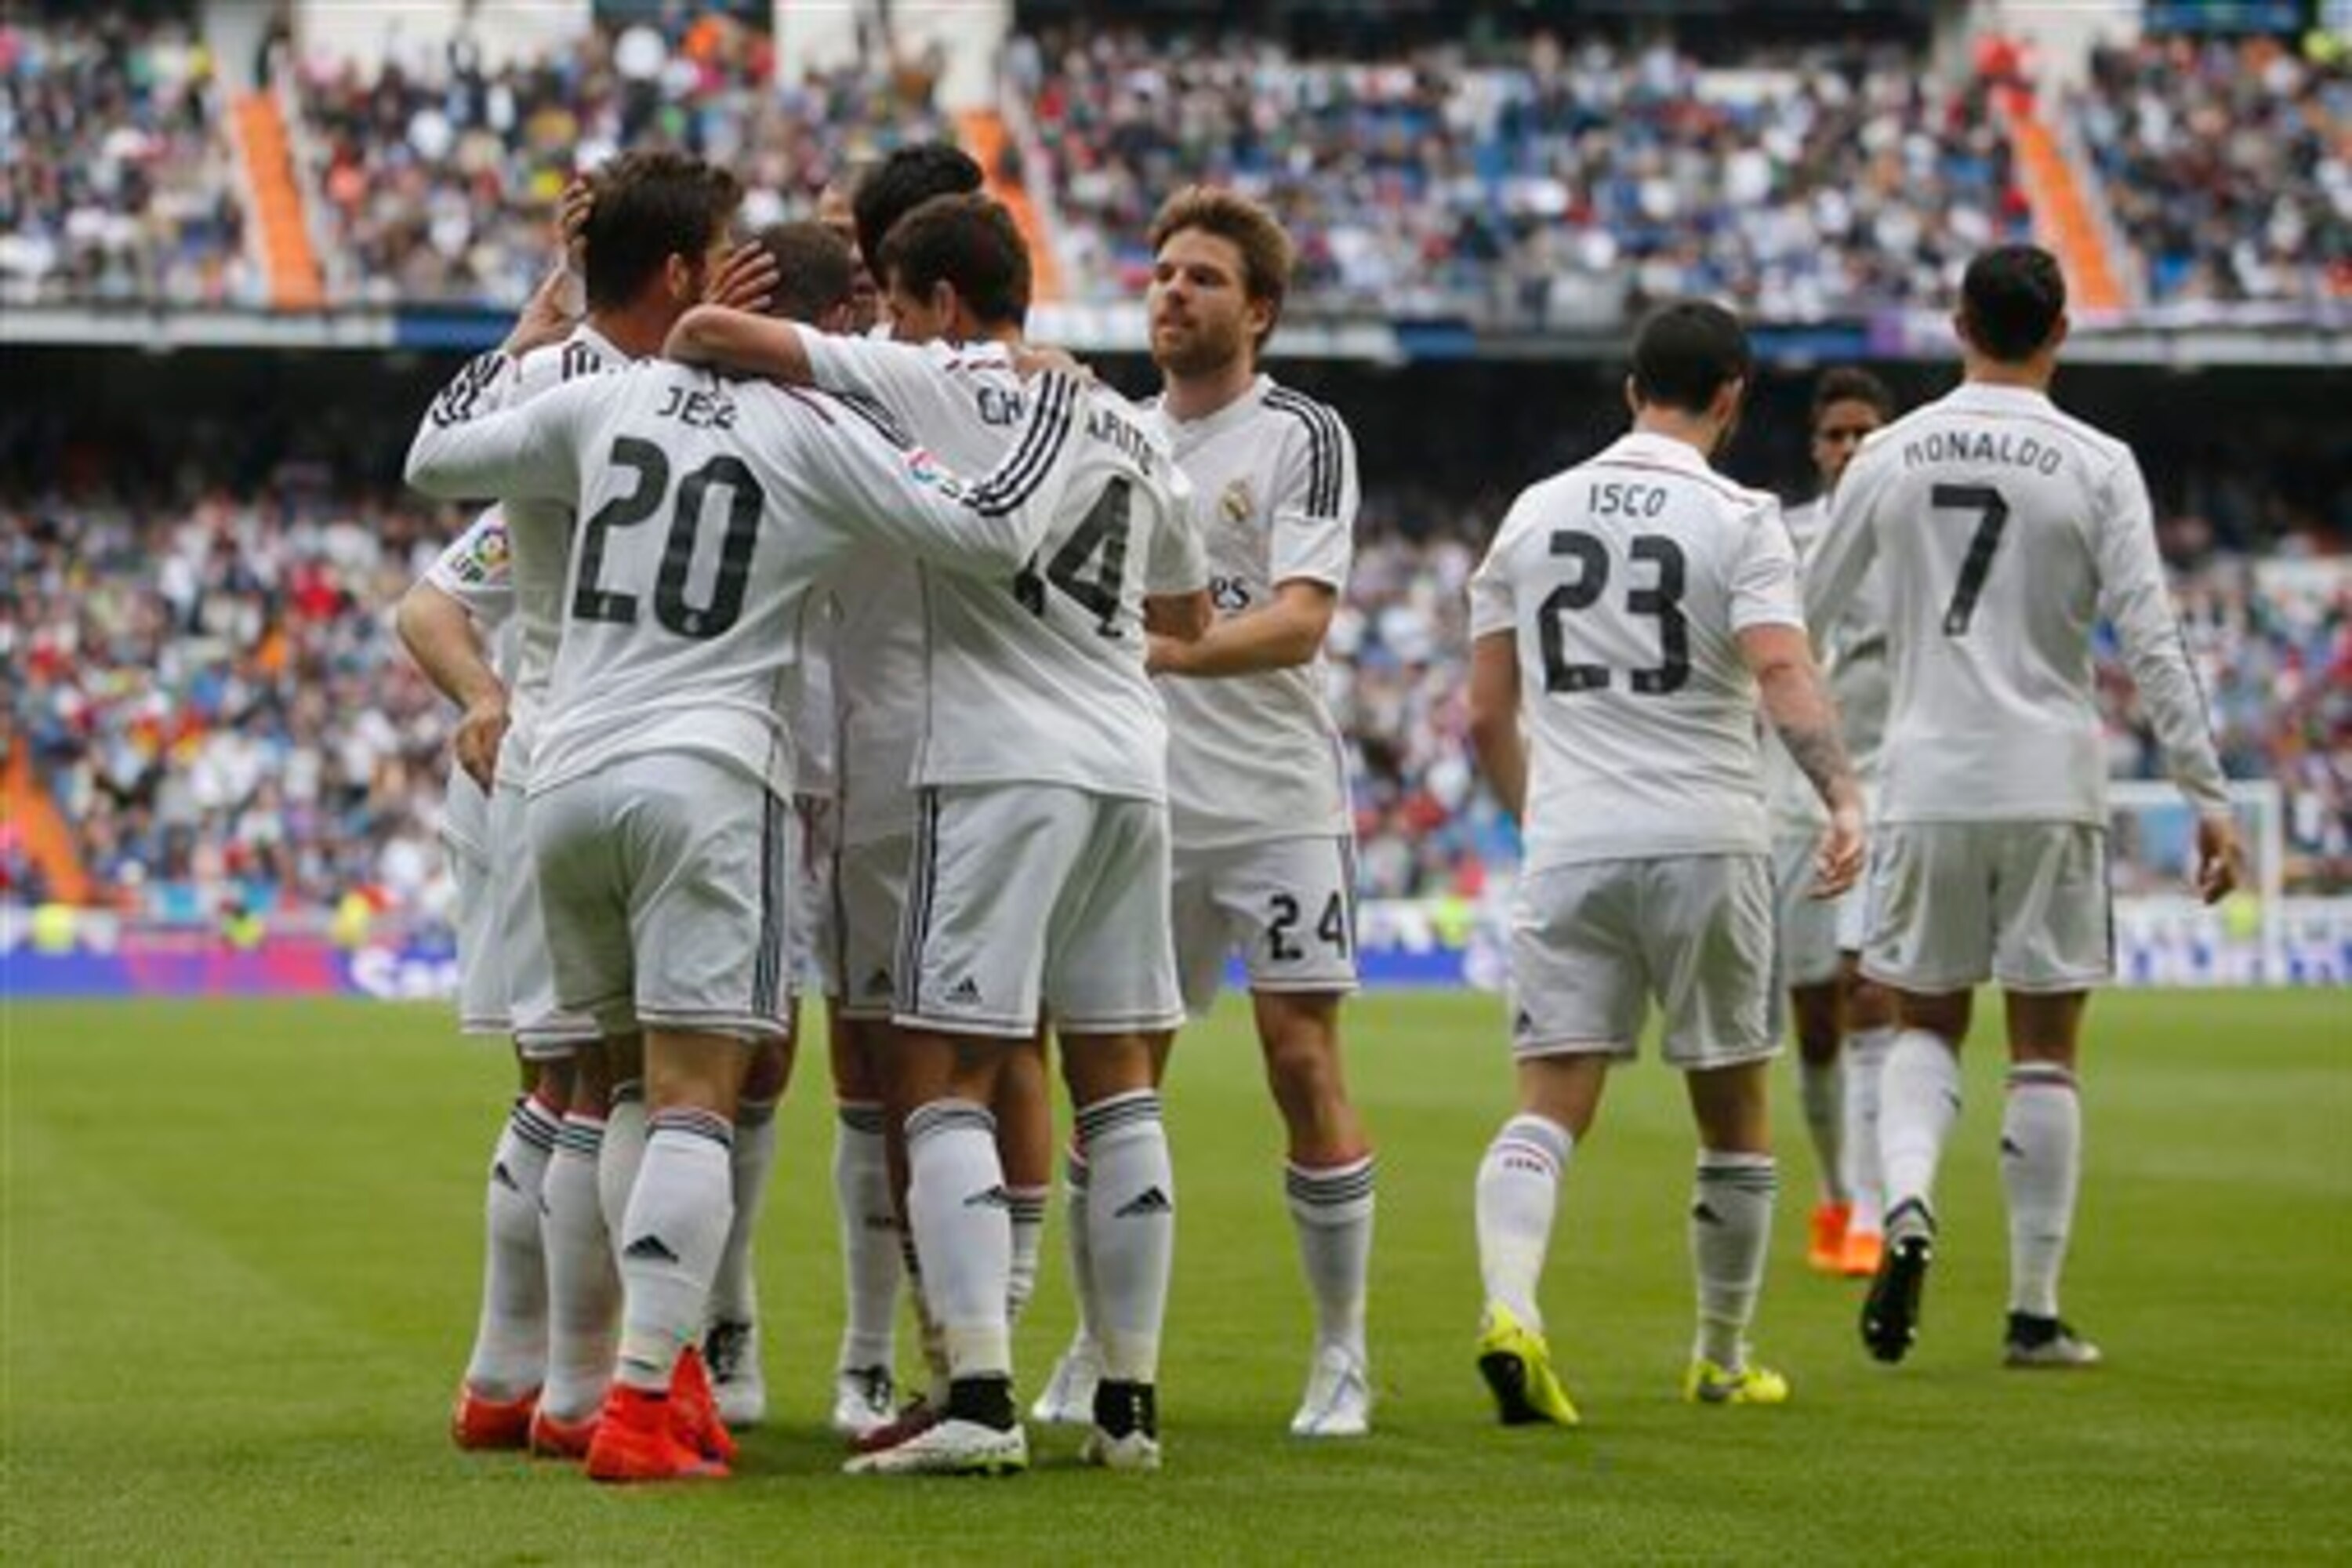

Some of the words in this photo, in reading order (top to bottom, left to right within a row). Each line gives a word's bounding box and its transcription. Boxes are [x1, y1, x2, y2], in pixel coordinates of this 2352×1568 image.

[1588, 484, 1667, 516] ISCO
[1904, 431, 2063, 476] RONALDO
[572, 436, 764, 638] 20
[1931, 485, 2008, 637] 7
[1538, 530, 1690, 693] 23
[1268, 890, 1346, 960] 24
